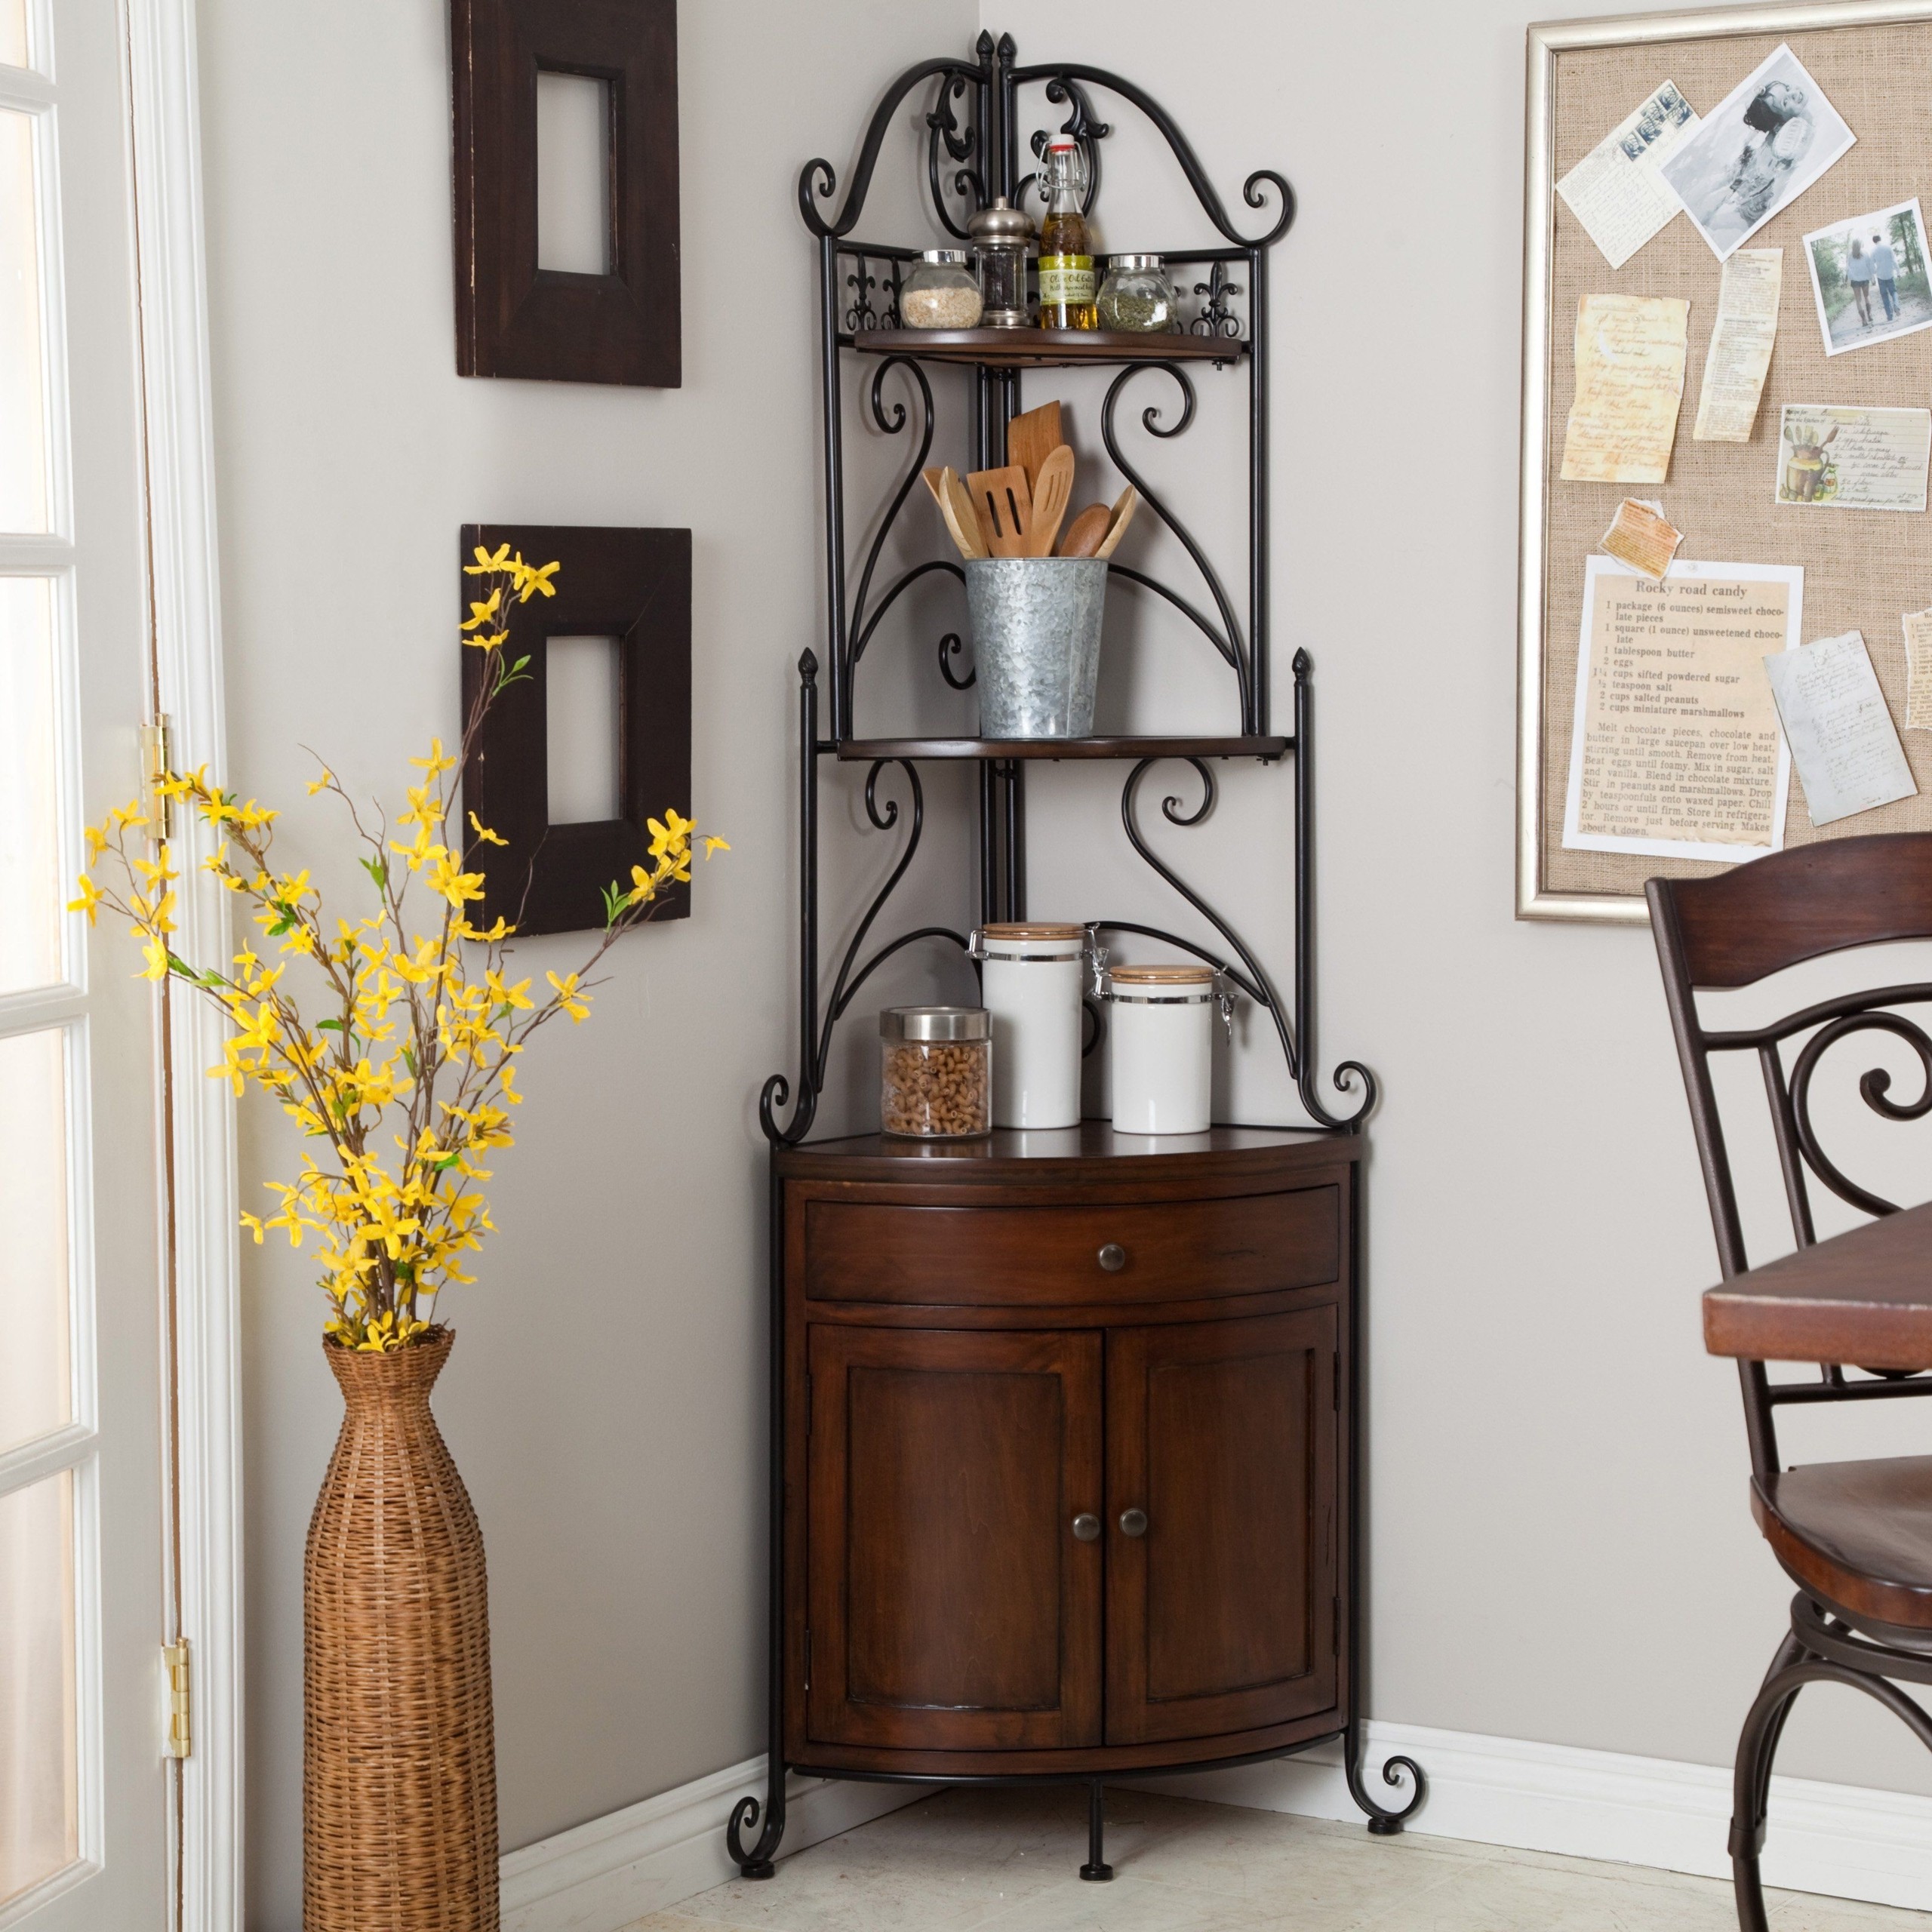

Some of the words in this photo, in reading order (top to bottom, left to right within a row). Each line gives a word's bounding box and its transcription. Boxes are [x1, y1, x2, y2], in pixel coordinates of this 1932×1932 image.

[1050, 275, 1066, 283] Olie
[1635, 580, 1674, 596] Rocky
[1679, 586, 1707, 595] road
[1712, 585, 1747, 599] candy
[1607, 601, 1611, 609] 1
[1616, 601, 1652, 611] package
[1657, 603, 1666, 612] (6
[1669, 605, 1703, 614] ounces)
[1706, 605, 1752, 614] semisweet
[1755, 607, 1784, 616] choco-
[1616, 612, 1632, 620] late
[1636, 613, 1663, 623] pieces
[1605, 623, 1609, 632] 1
[1615, 625, 1645, 633] square
[1649, 626, 1656, 635] (1
[1660, 627, 1689, 636] ounce)
[1693, 628, 1751, 638] unsweetened
[1754, 629, 1783, 638] choco-
[1617, 635, 1633, 643] late
[1614, 647, 1662, 657] tablespoon
[1667, 648, 1695, 658] butter
[1614, 659, 1633, 668] eggs
[1613, 671, 1633, 679] cups
[1638, 670, 1663, 679] sifted
[1667, 672, 1710, 681] powdered
[1715, 675, 1740, 685] sugar
[1612, 681, 1651, 691] teaspoon
[1657, 683, 1672, 691] salt
[1610, 694, 1630, 703] cups
[1634, 694, 1660, 703] salted
[1610, 705, 1630, 713] cups
[1633, 705, 1677, 715] miniature
[1681, 708, 1745, 718] marshmallows
[1598, 722, 1617, 732] Melt
[1624, 724, 1666, 734] chocolate
[1709, 728, 1752, 739] chocolate
[1758, 731, 1775, 740] and
[1587, 733, 1614, 743] butter
[1621, 735, 1630, 744] in
[1637, 736, 1660, 747] large
[1665, 740, 1706, 749] saucepan
[1733, 742, 1749, 750] low
[1752, 743, 1774, 753] heat,
[1586, 745, 1620, 756] stirring
[1623, 747, 1644, 755] until
[1648, 749, 1682, 758] smooth.
[1687, 750, 1722, 760] Remove
[1725, 752, 1748, 761] from
[1752, 754, 1774, 763] heat.
[1585, 755, 1604, 764] Beat
[1612, 759, 1632, 768] eggs
[1636, 759, 1657, 768] until
[1660, 760, 1690, 771] foamy.
[1694, 762, 1710, 771] Mix
[1715, 763, 1723, 772] in
[1758, 766, 1774, 774] salt
[1584, 768, 1600, 776] and
[1607, 769, 1641, 778] vanilla.
[1646, 771, 1672, 780] Blend
[1675, 772, 1684, 781] in
[1688, 774, 1730, 783] chocolate
[1734, 776, 1772, 786] mixture.
[1583, 778, 1600, 787] Stir
[1607, 780, 1615, 788] in
[1620, 781, 1656, 791] peanuts
[1659, 784, 1675, 792] and
[1679, 785, 1746, 796] marshmallows.
[1749, 788, 1771, 799] Drop
[1583, 789, 1594, 799] by
[1600, 791, 1657, 801] teaspoonfuls
[1662, 795, 1681, 804] onto
[1685, 797, 1713, 805] waxed
[1717, 800, 1745, 808] paper.
[1749, 800, 1770, 809] Chill
[1582, 801, 1587, 809] 2
[1594, 801, 1619, 811] hours
[1636, 805, 1657, 814] until
[1662, 805, 1683, 815] firm.
[1687, 808, 1711, 817] Store
[1714, 809, 1722, 817] in
[1727, 810, 1770, 821] refrigera-
[1582, 812, 1596, 820] tor.
[1603, 814, 1638, 823] Remove
[1645, 816, 1663, 826] just
[1669, 817, 1698, 827] before
[1741, 822, 1770, 832] Makes
[1583, 823, 1606, 832] about
[1621, 826, 1649, 835] dozen.
